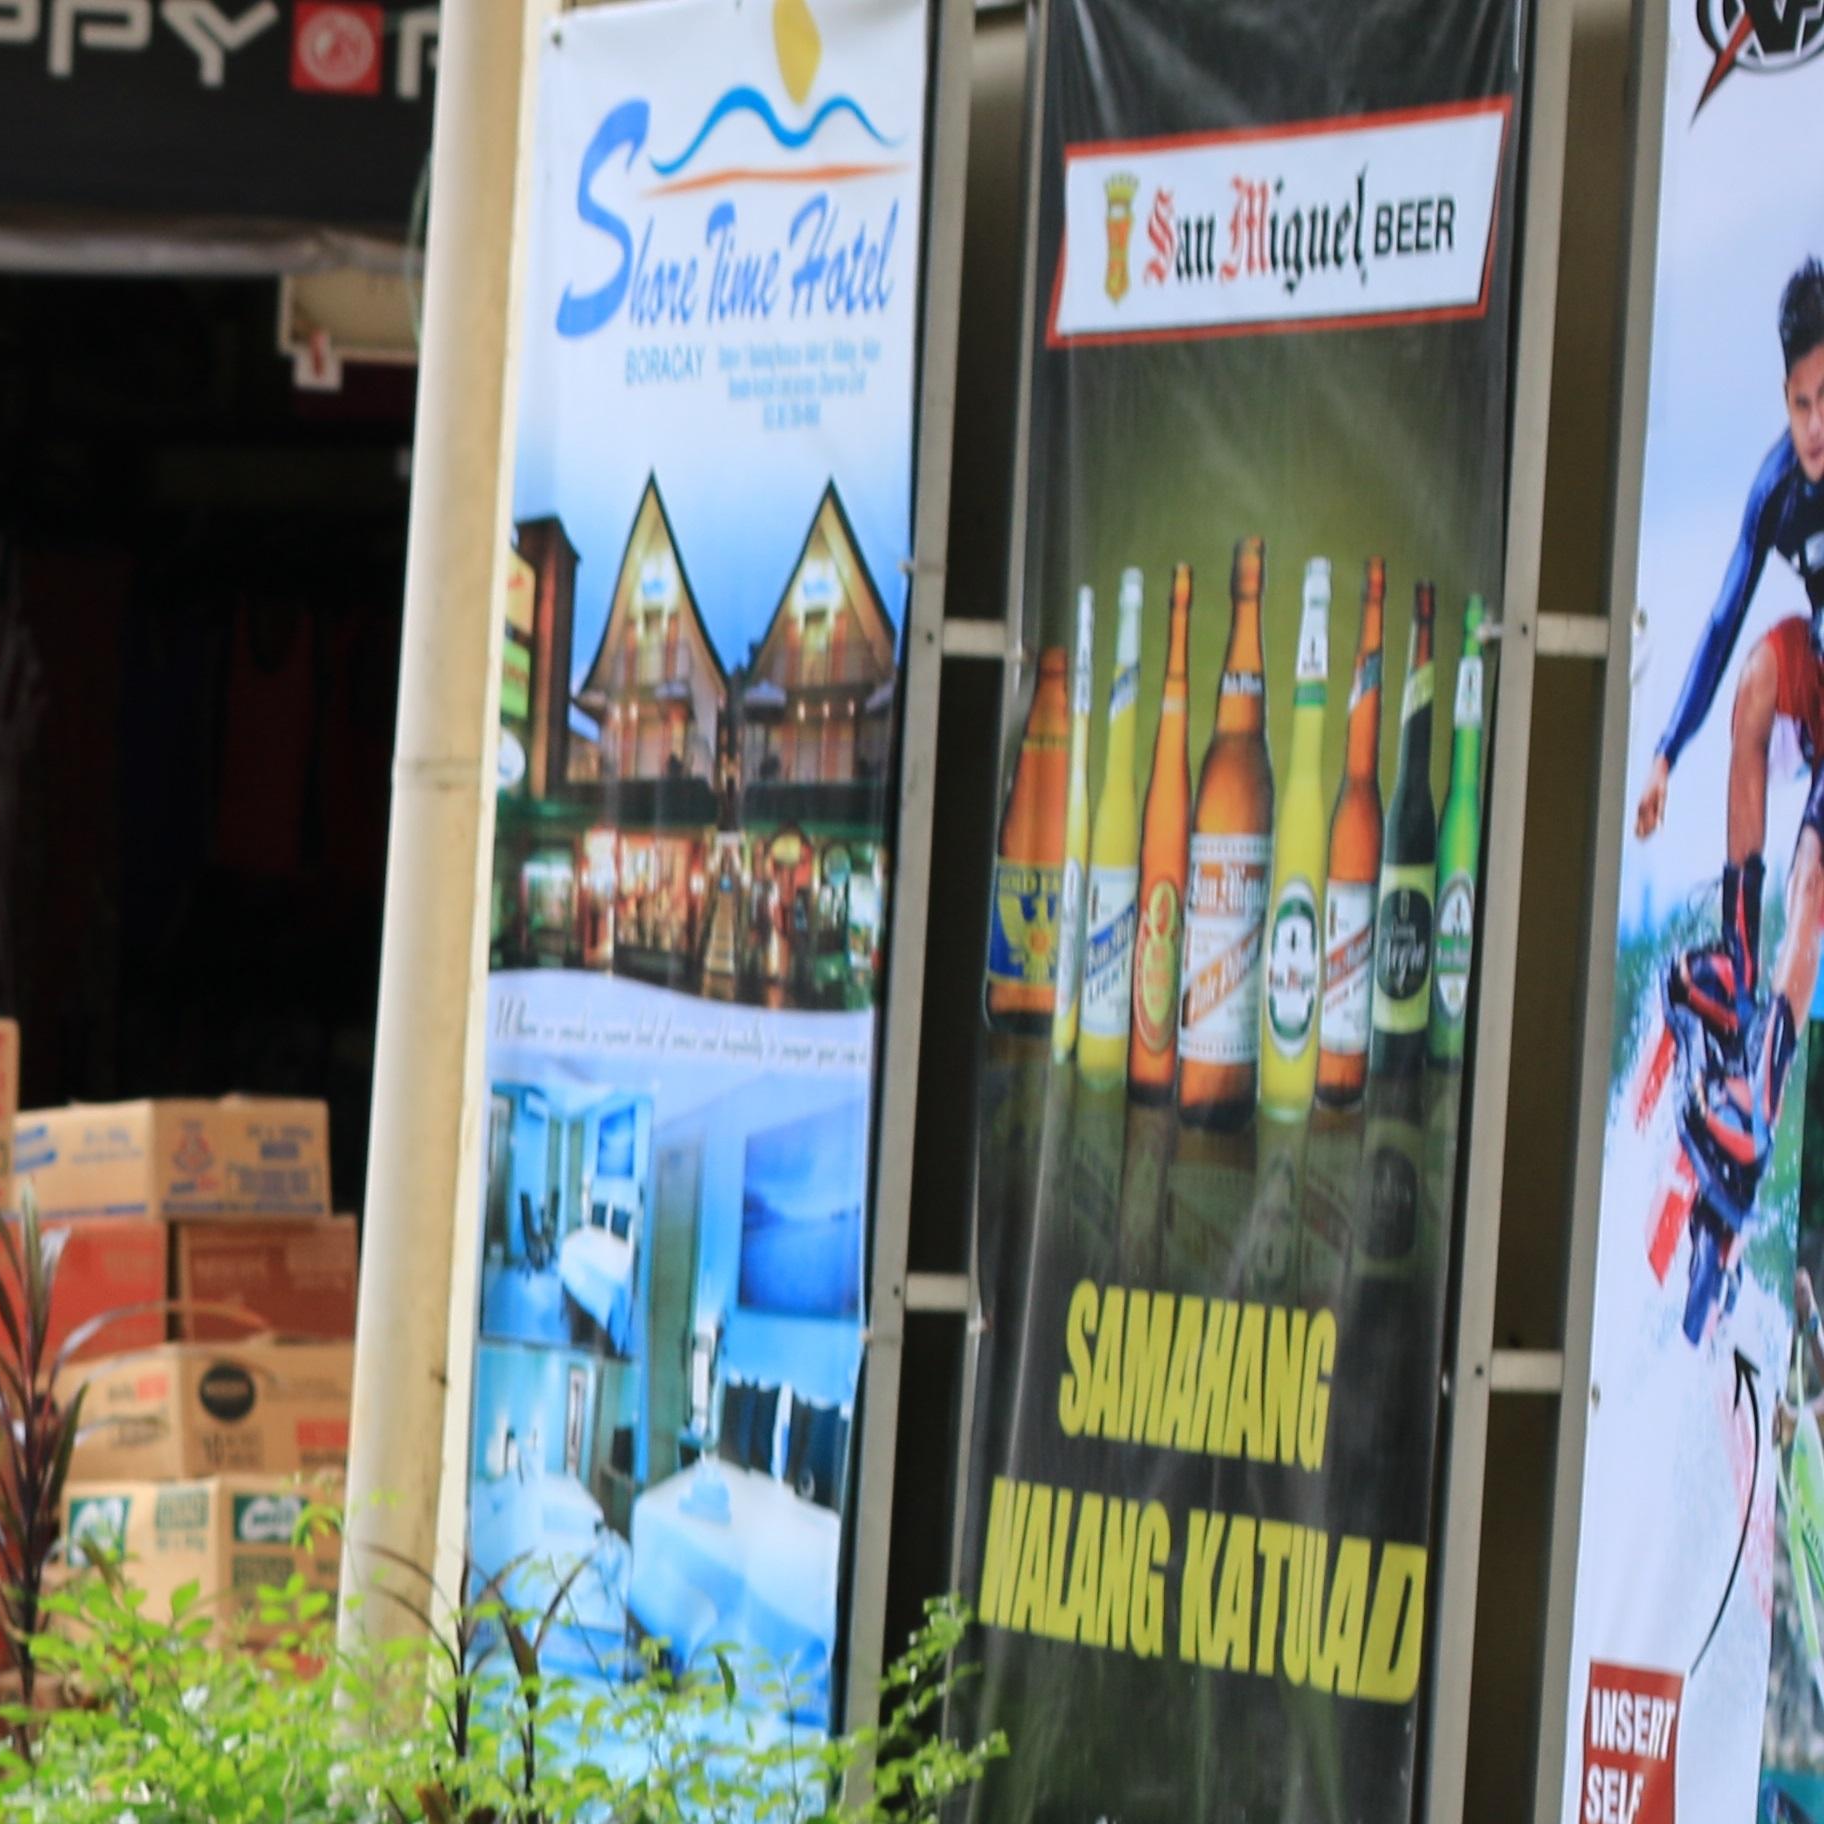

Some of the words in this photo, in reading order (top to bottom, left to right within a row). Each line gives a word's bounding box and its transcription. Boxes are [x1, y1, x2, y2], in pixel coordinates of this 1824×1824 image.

[555, 98, 702, 342] Shore
[704, 198, 784, 326] Time
[786, 190, 902, 320] Hotel
[1144, 186, 1217, 286] San
[1218, 160, 1369, 298] Miguel
[1373, 196, 1457, 257] BEER
[1058, 1279, 1337, 1472] SAMAHANG
[978, 1475, 1171, 1660] WALANG
[1179, 1507, 1428, 1706] KATULAD
[1589, 1685, 1677, 1761] INSERT
